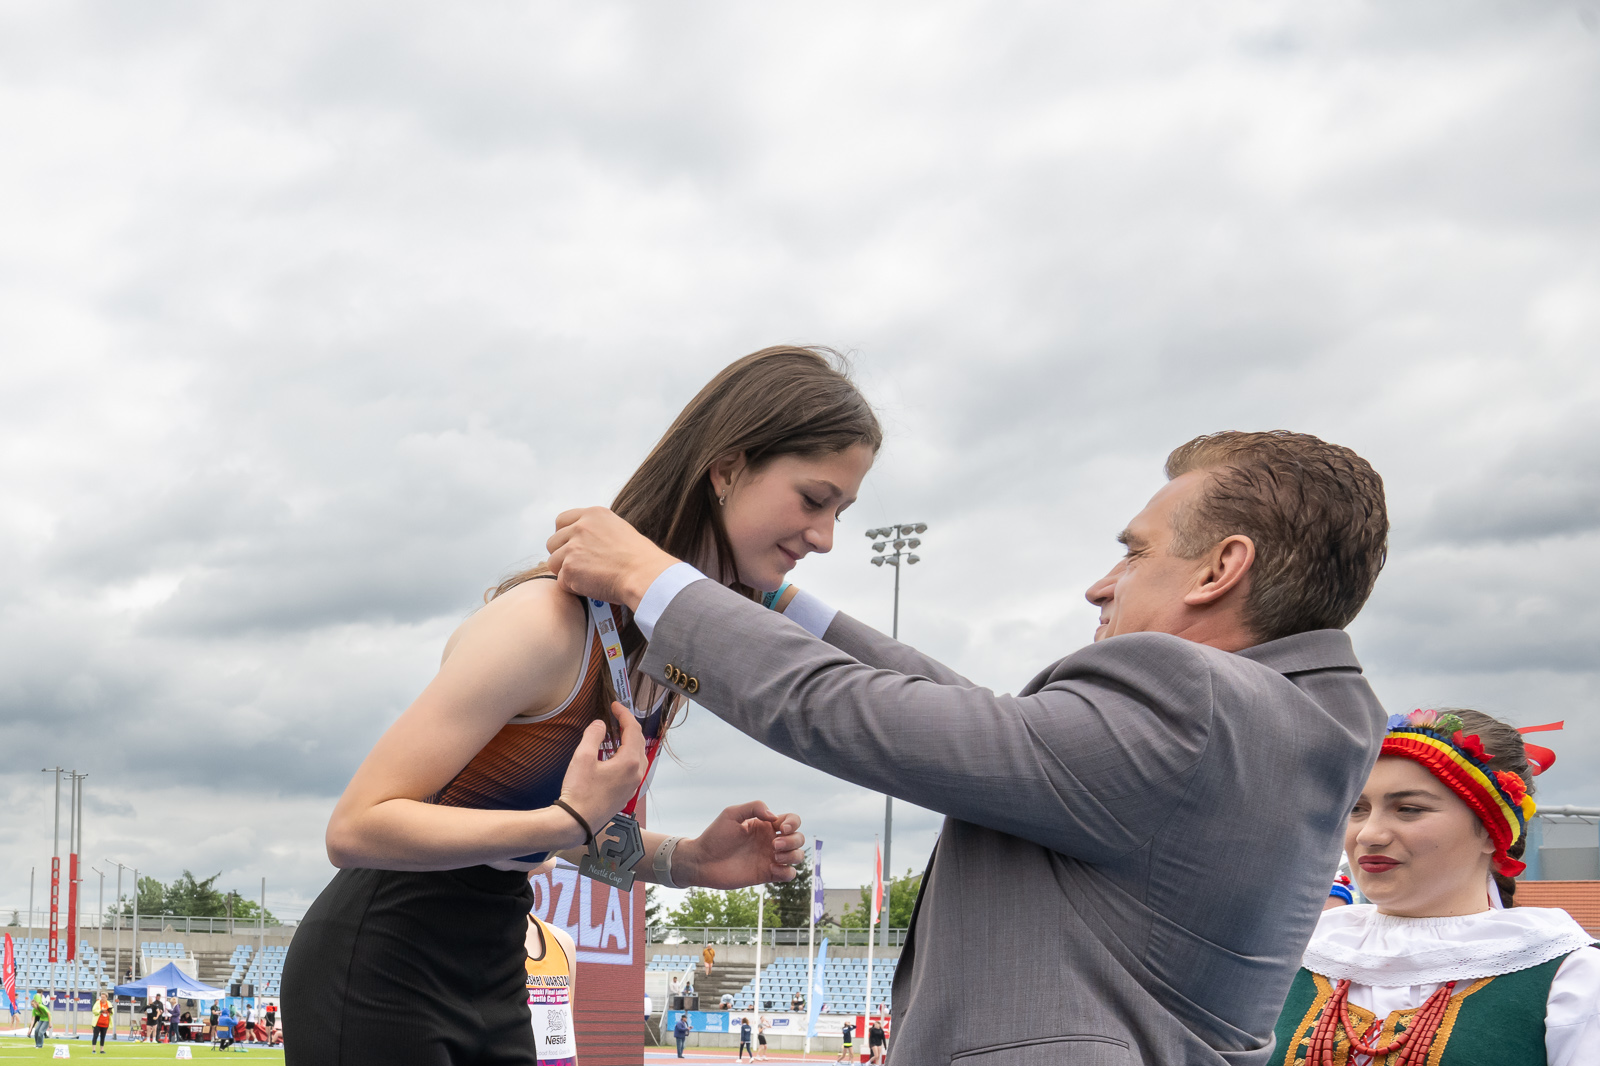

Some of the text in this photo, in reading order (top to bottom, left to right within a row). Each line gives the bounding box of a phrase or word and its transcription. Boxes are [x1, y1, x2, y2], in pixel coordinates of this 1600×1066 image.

[587, 864, 623, 885] Nestlé Cup
[545, 1034, 567, 1045] Nestlé
[55, 1048, 64, 1056] 25
